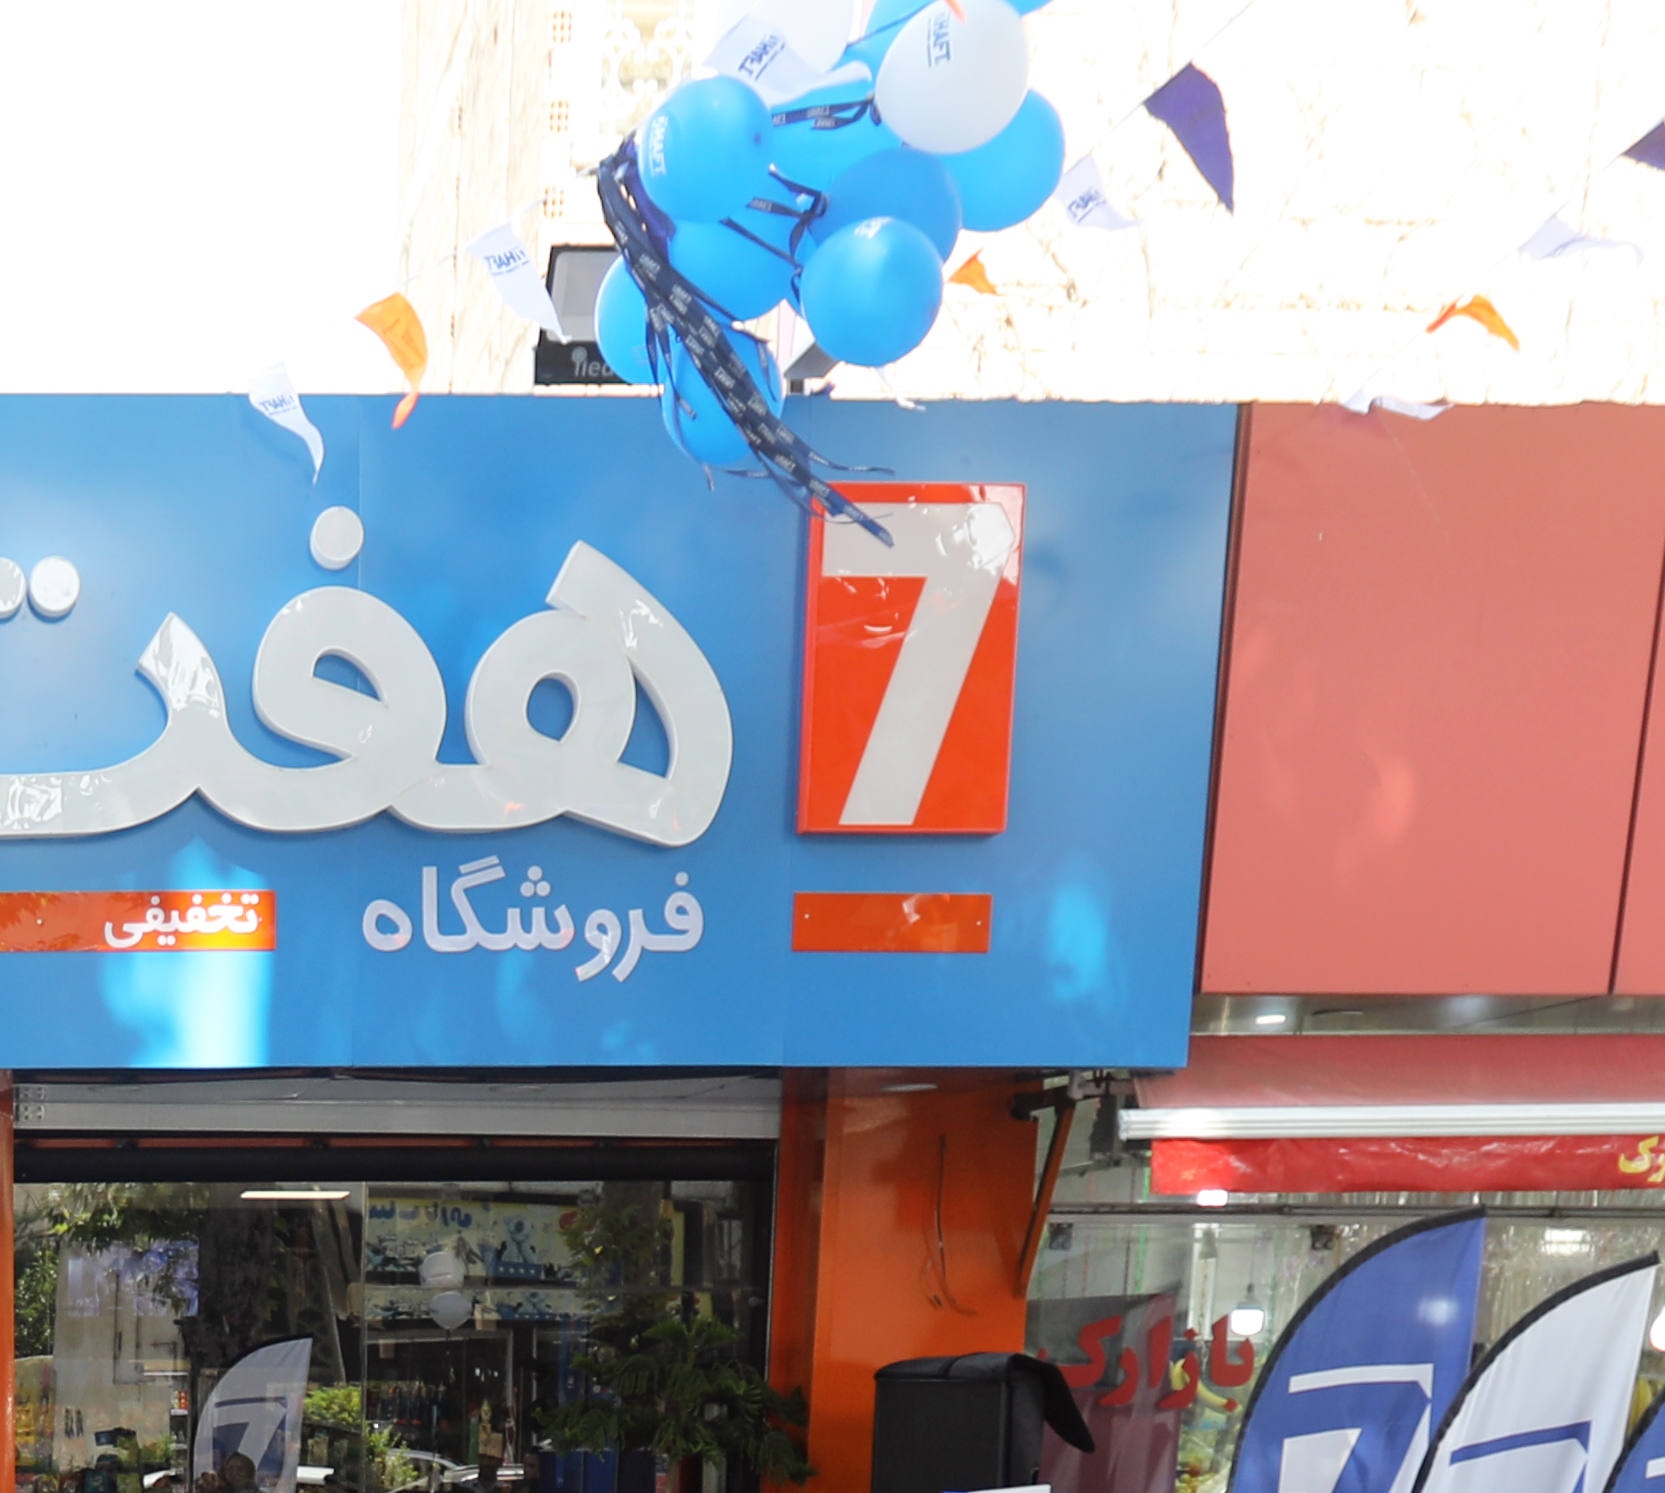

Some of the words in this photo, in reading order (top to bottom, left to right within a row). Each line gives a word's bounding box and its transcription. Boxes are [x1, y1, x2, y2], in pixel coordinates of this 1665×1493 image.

[816, 500, 1017, 828] 7
[101, 889, 260, 950] تخفیفی
[360, 855, 706, 984] فروشگاه
